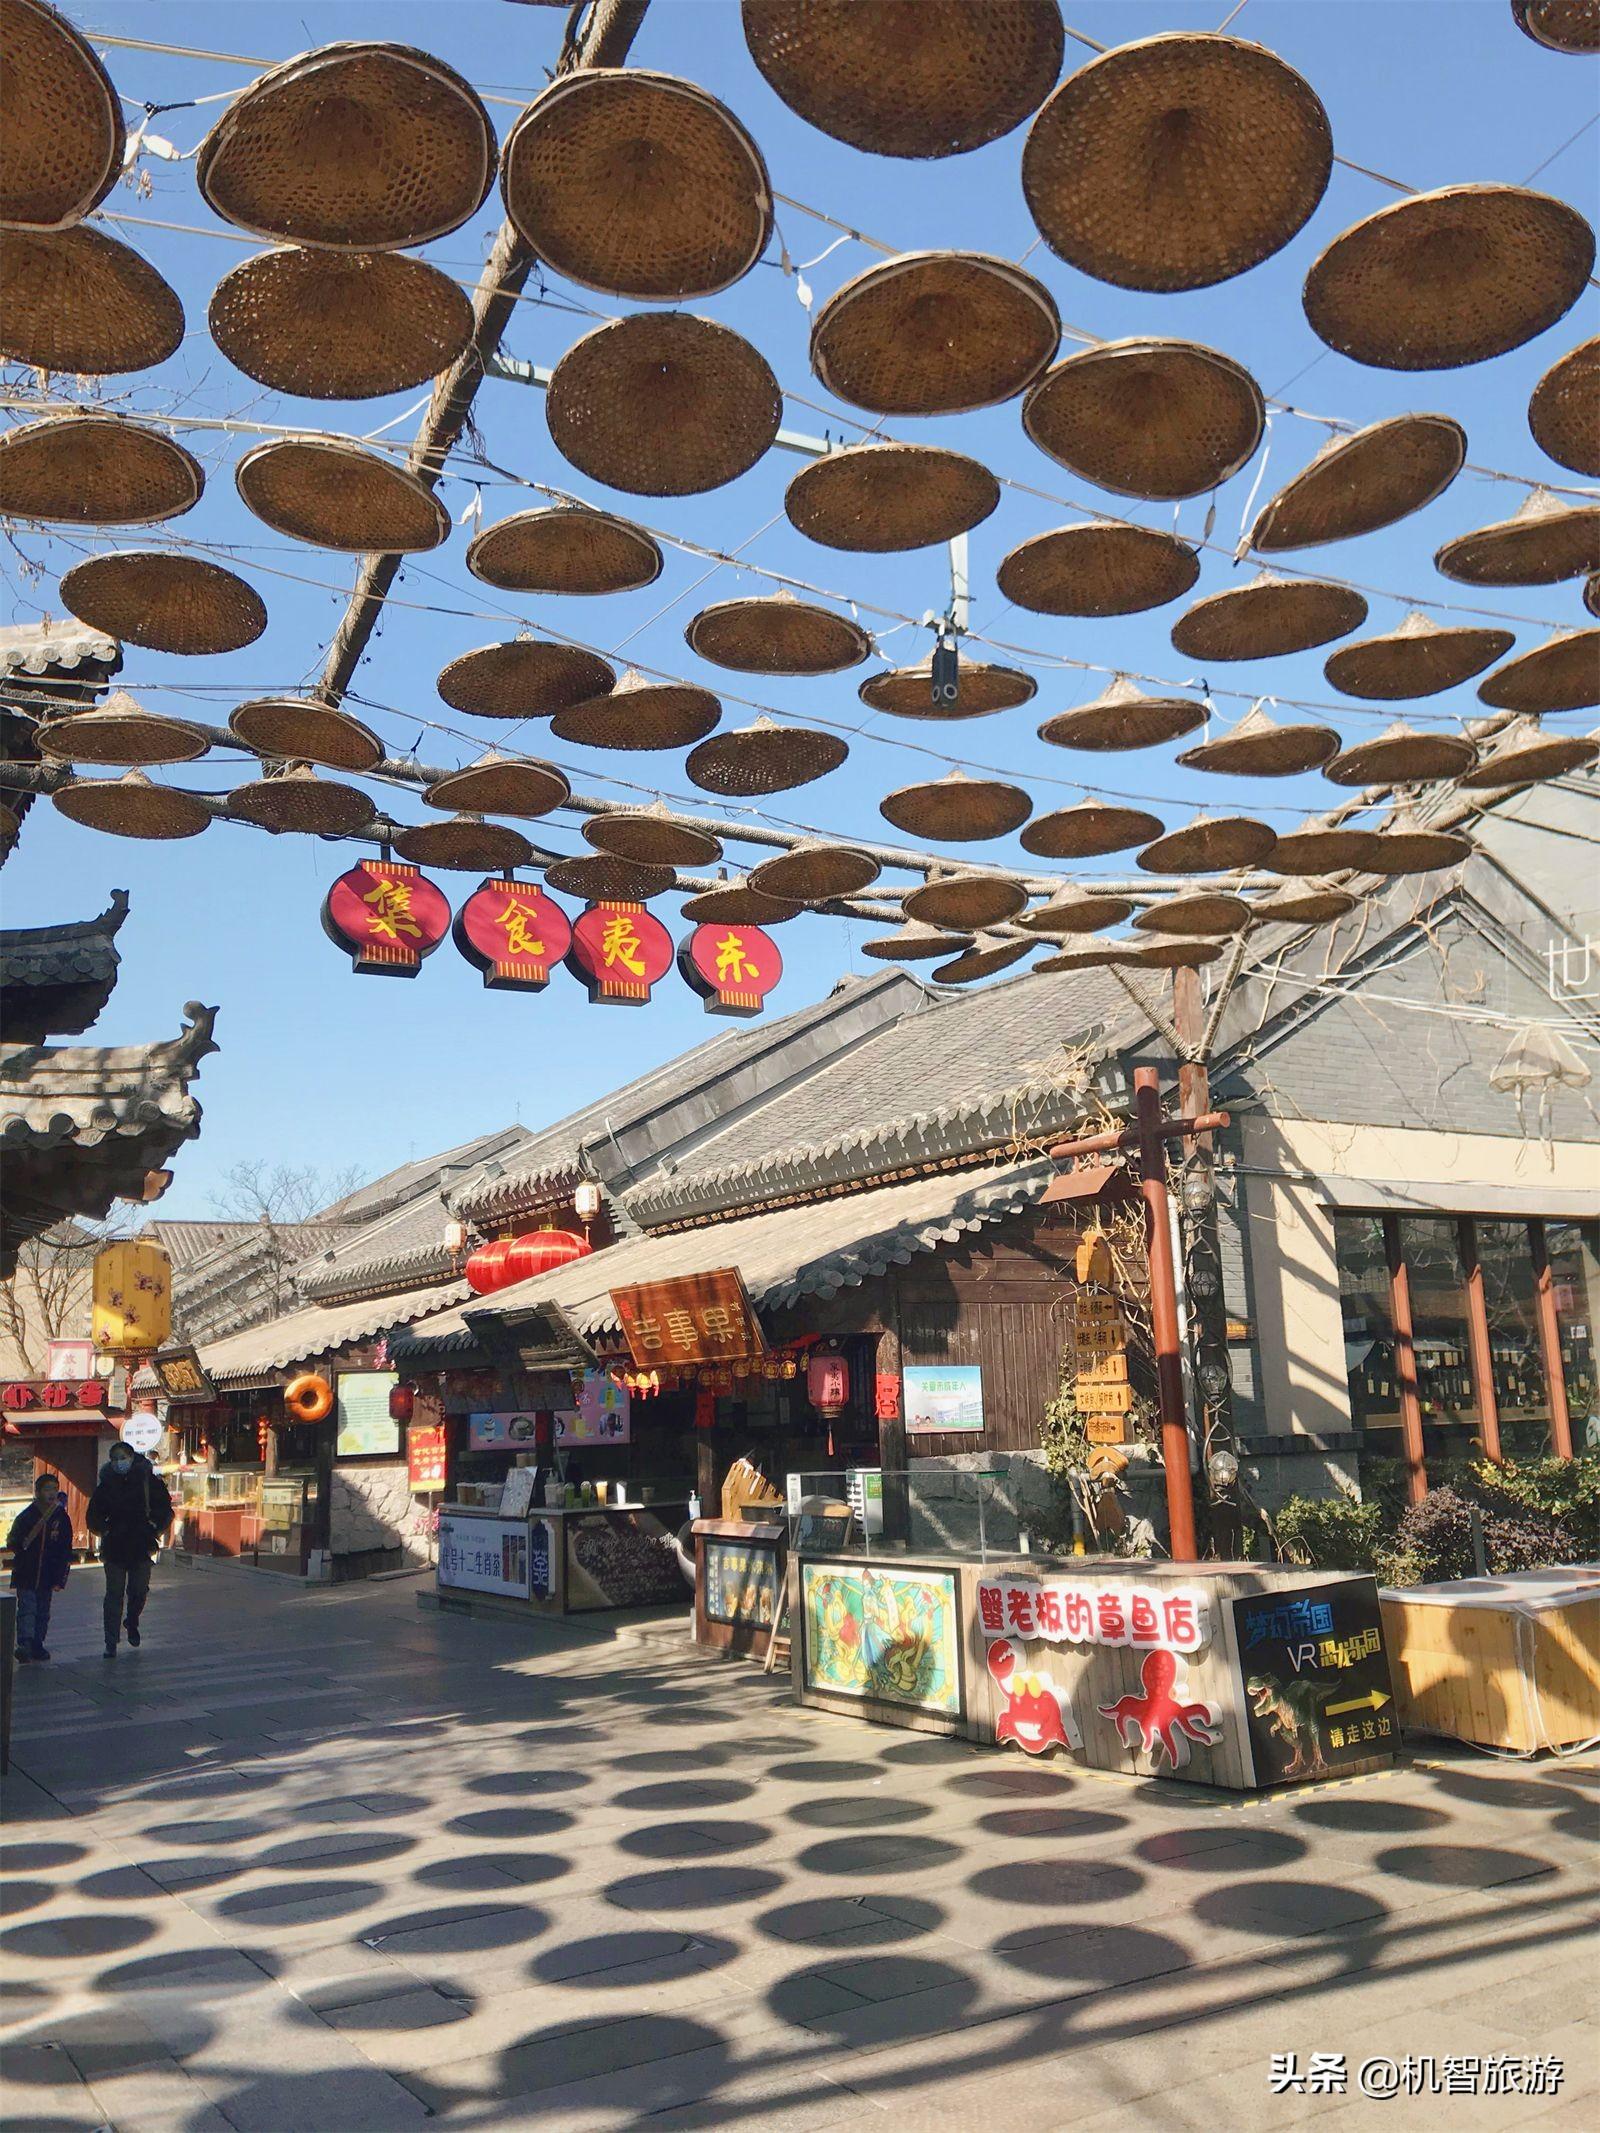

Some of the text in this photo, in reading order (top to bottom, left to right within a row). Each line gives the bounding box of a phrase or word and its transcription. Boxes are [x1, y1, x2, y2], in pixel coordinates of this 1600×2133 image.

[442, 1546, 501, 1578] 代号十二生肖茶
[979, 1585, 1197, 1644] 蟹老板的章鱼店
[1330, 1716, 1393, 1749] 请走这边
